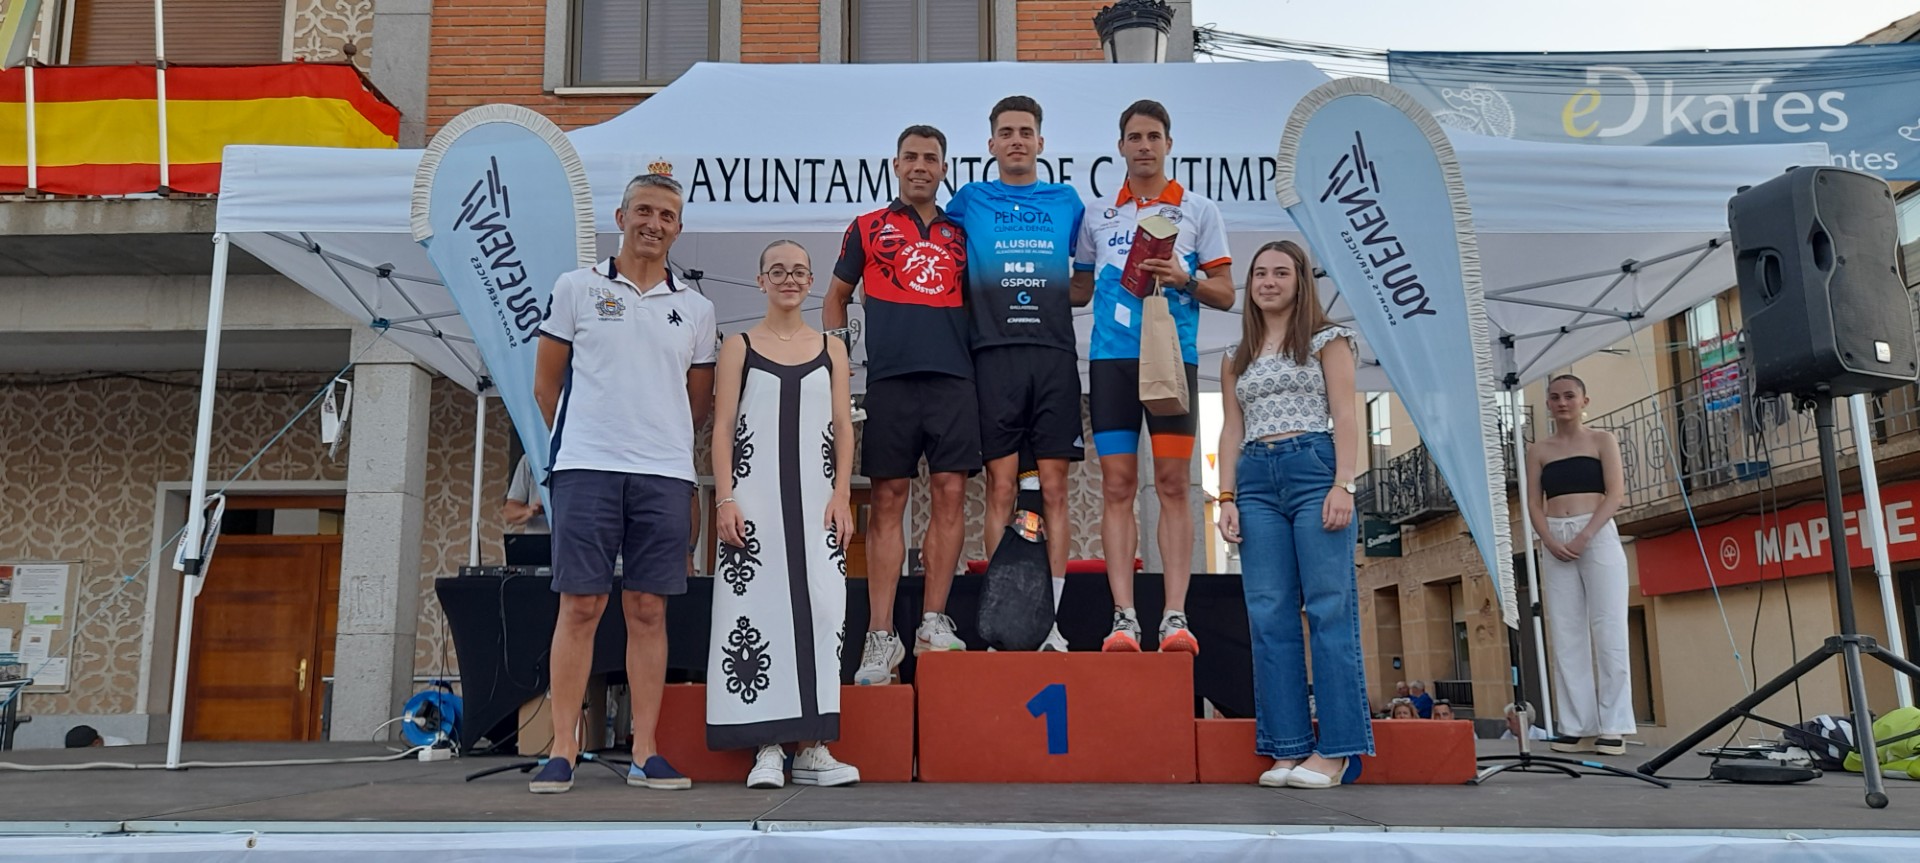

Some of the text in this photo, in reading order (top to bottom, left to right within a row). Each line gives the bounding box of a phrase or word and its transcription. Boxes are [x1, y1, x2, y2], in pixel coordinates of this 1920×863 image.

[1026, 225, 1056, 234] DENTAL
[994, 239, 1055, 250] ALUSIGMA
[901, 241, 951, 260] TRI INFINITY
[1001, 278, 1048, 288] GSPORT
[1025, 683, 1069, 755] 1
